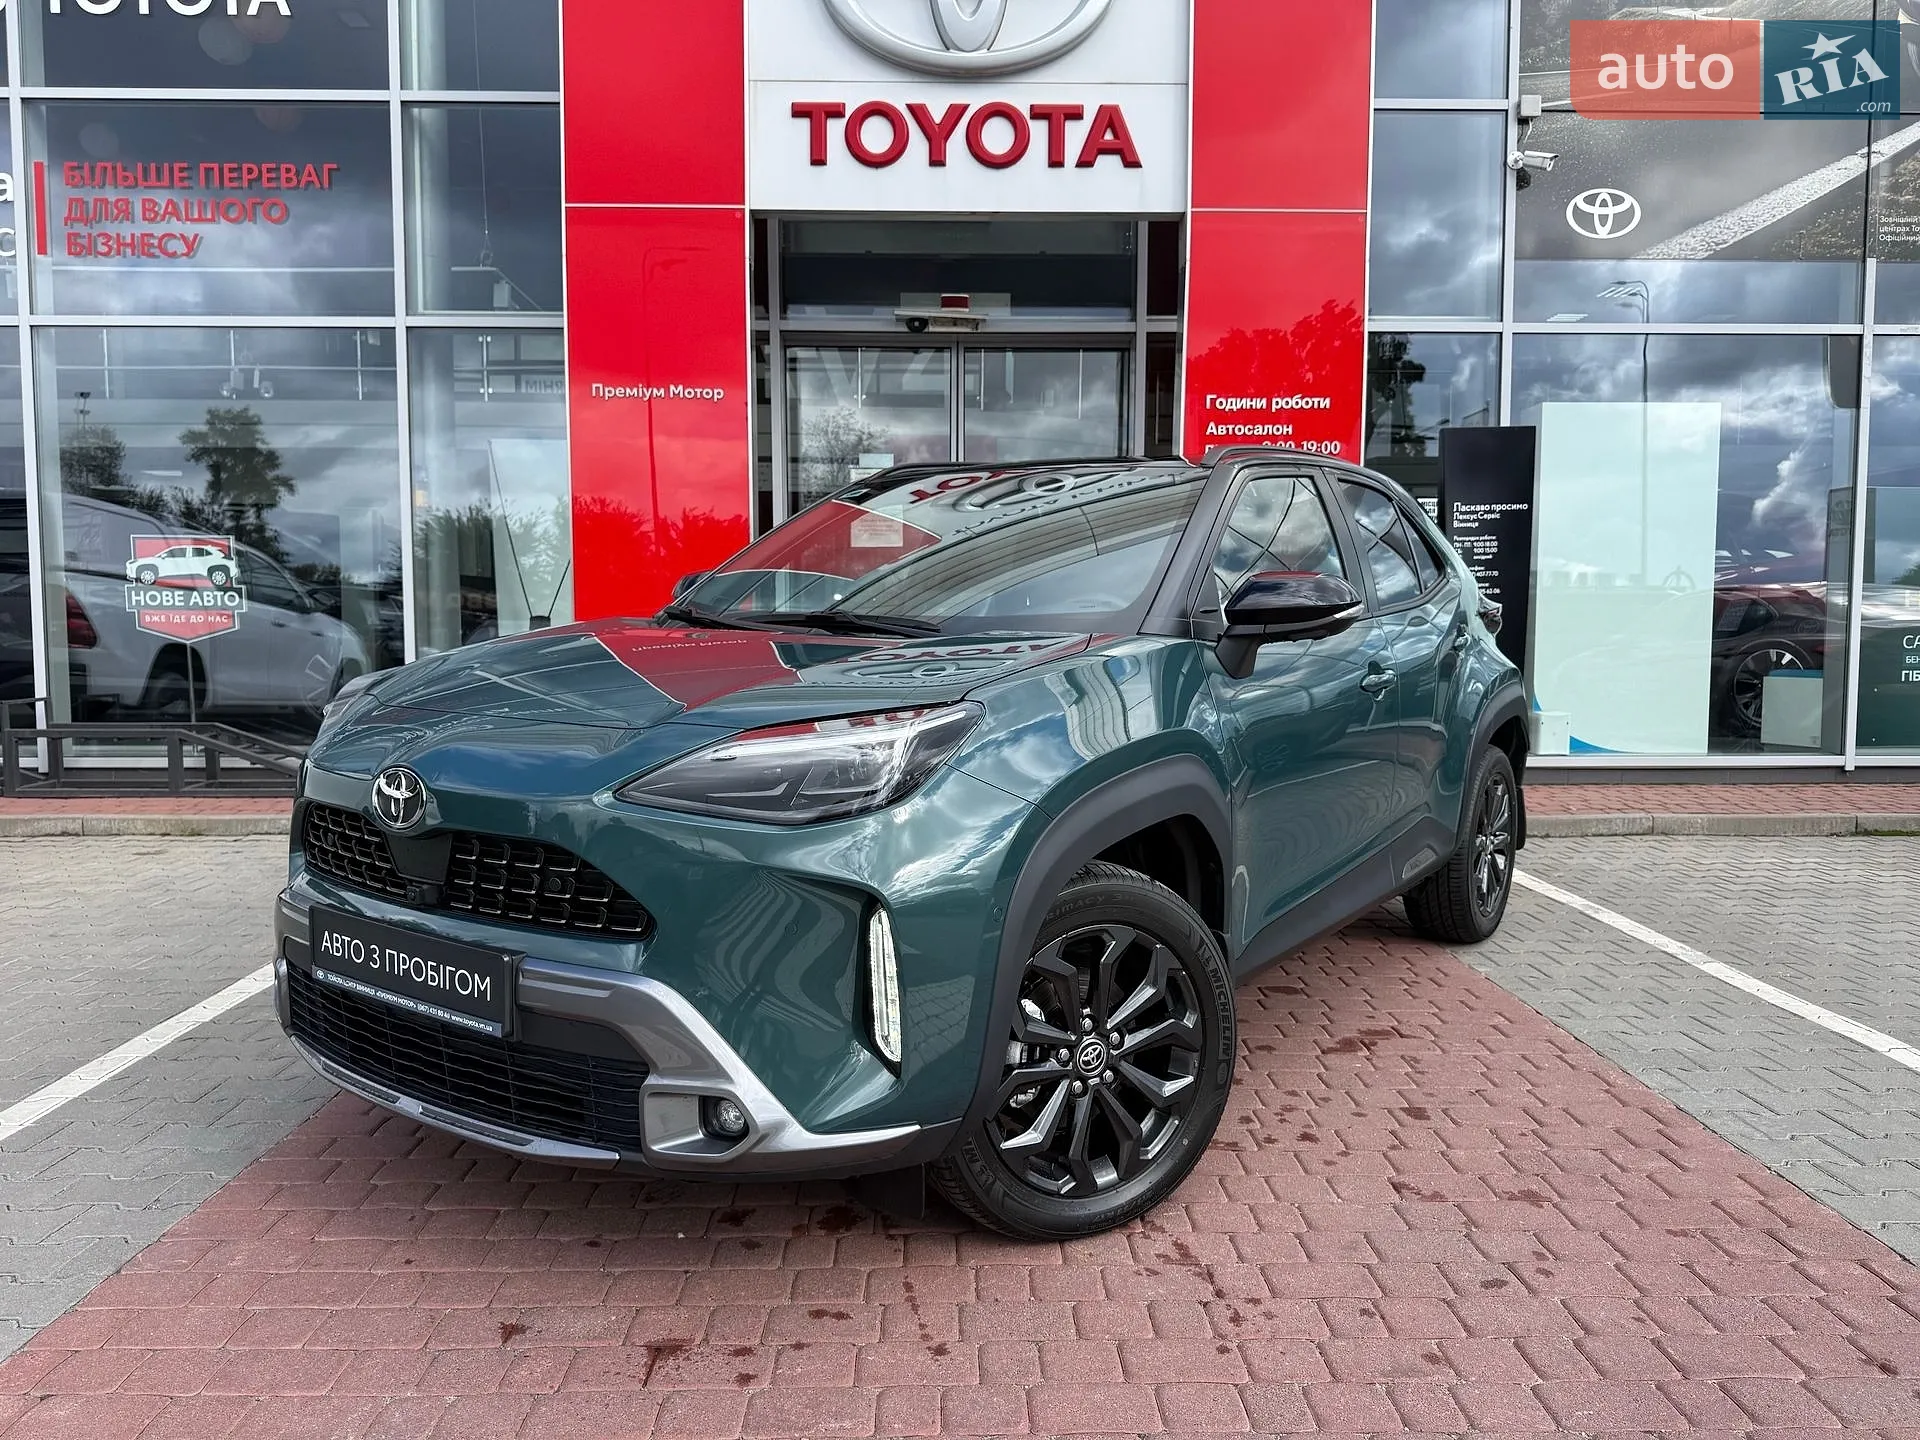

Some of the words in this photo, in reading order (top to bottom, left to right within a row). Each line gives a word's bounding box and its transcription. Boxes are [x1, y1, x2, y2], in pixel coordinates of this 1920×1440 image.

[791, 100, 1143, 169] TOYOTA
[63, 161, 189, 187] БІЛЬШЕ
[199, 163, 338, 189] ПЕРЕВАГ
[64, 197, 131, 226] ДЛЯ
[141, 198, 289, 224] ВАШОГО
[66, 232, 200, 258] БІЗНЕСУ
[591, 383, 665, 400] Преміум
[669, 384, 724, 402] Мотор
[1205, 394, 1267, 411] Години
[1271, 394, 1331, 412] роботи
[1205, 421, 1293, 435] Автосалон
[1491, 503, 1528, 512] просимо
[131, 590, 185, 606] НОВЕ
[189, 590, 240, 606] АВТО
[145, 615, 166, 623] ВЖЕ
[170, 614, 186, 624] ЇДЕ
[190, 615, 204, 624] ДО
[208, 615, 228, 623] НАС
[321, 930, 365, 964] АВТО
[385, 949, 491, 1002] ПРОБІГОМ
[1208, 967, 1231, 1059] MICHELIN
